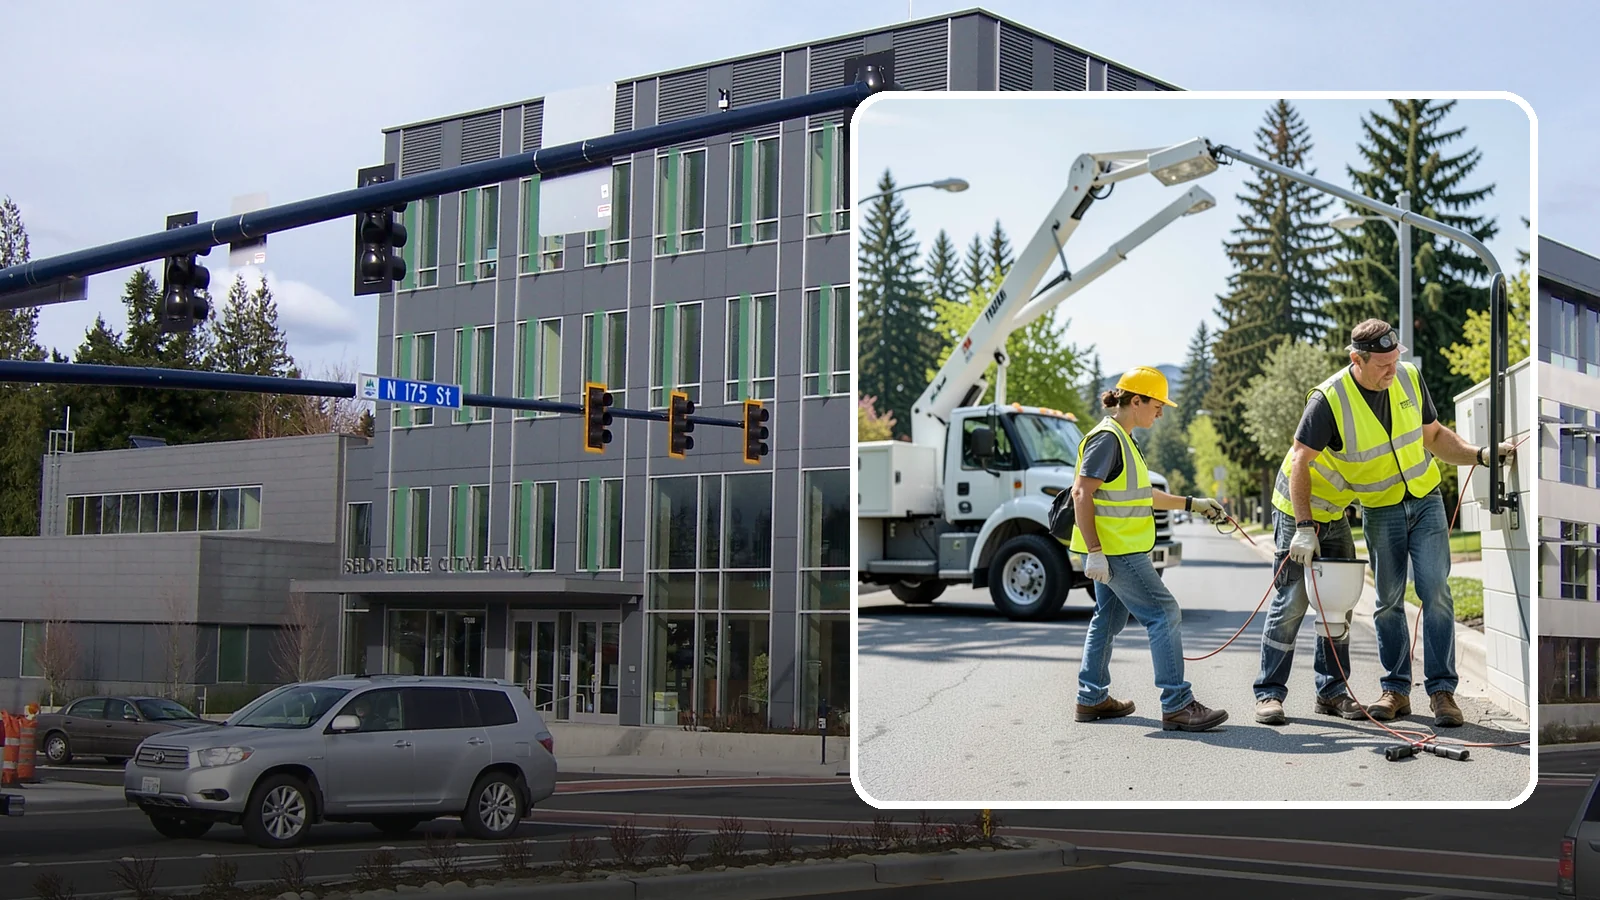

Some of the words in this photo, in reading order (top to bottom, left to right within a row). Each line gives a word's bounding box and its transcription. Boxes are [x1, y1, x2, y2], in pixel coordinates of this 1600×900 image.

[387, 380, 396, 399] N
[405, 383, 427, 403] 175
[436, 386, 451, 405] St
[345, 556, 431, 574] SHORELINE
[438, 556, 474, 572] CITY
[484, 556, 525, 571] HALL
